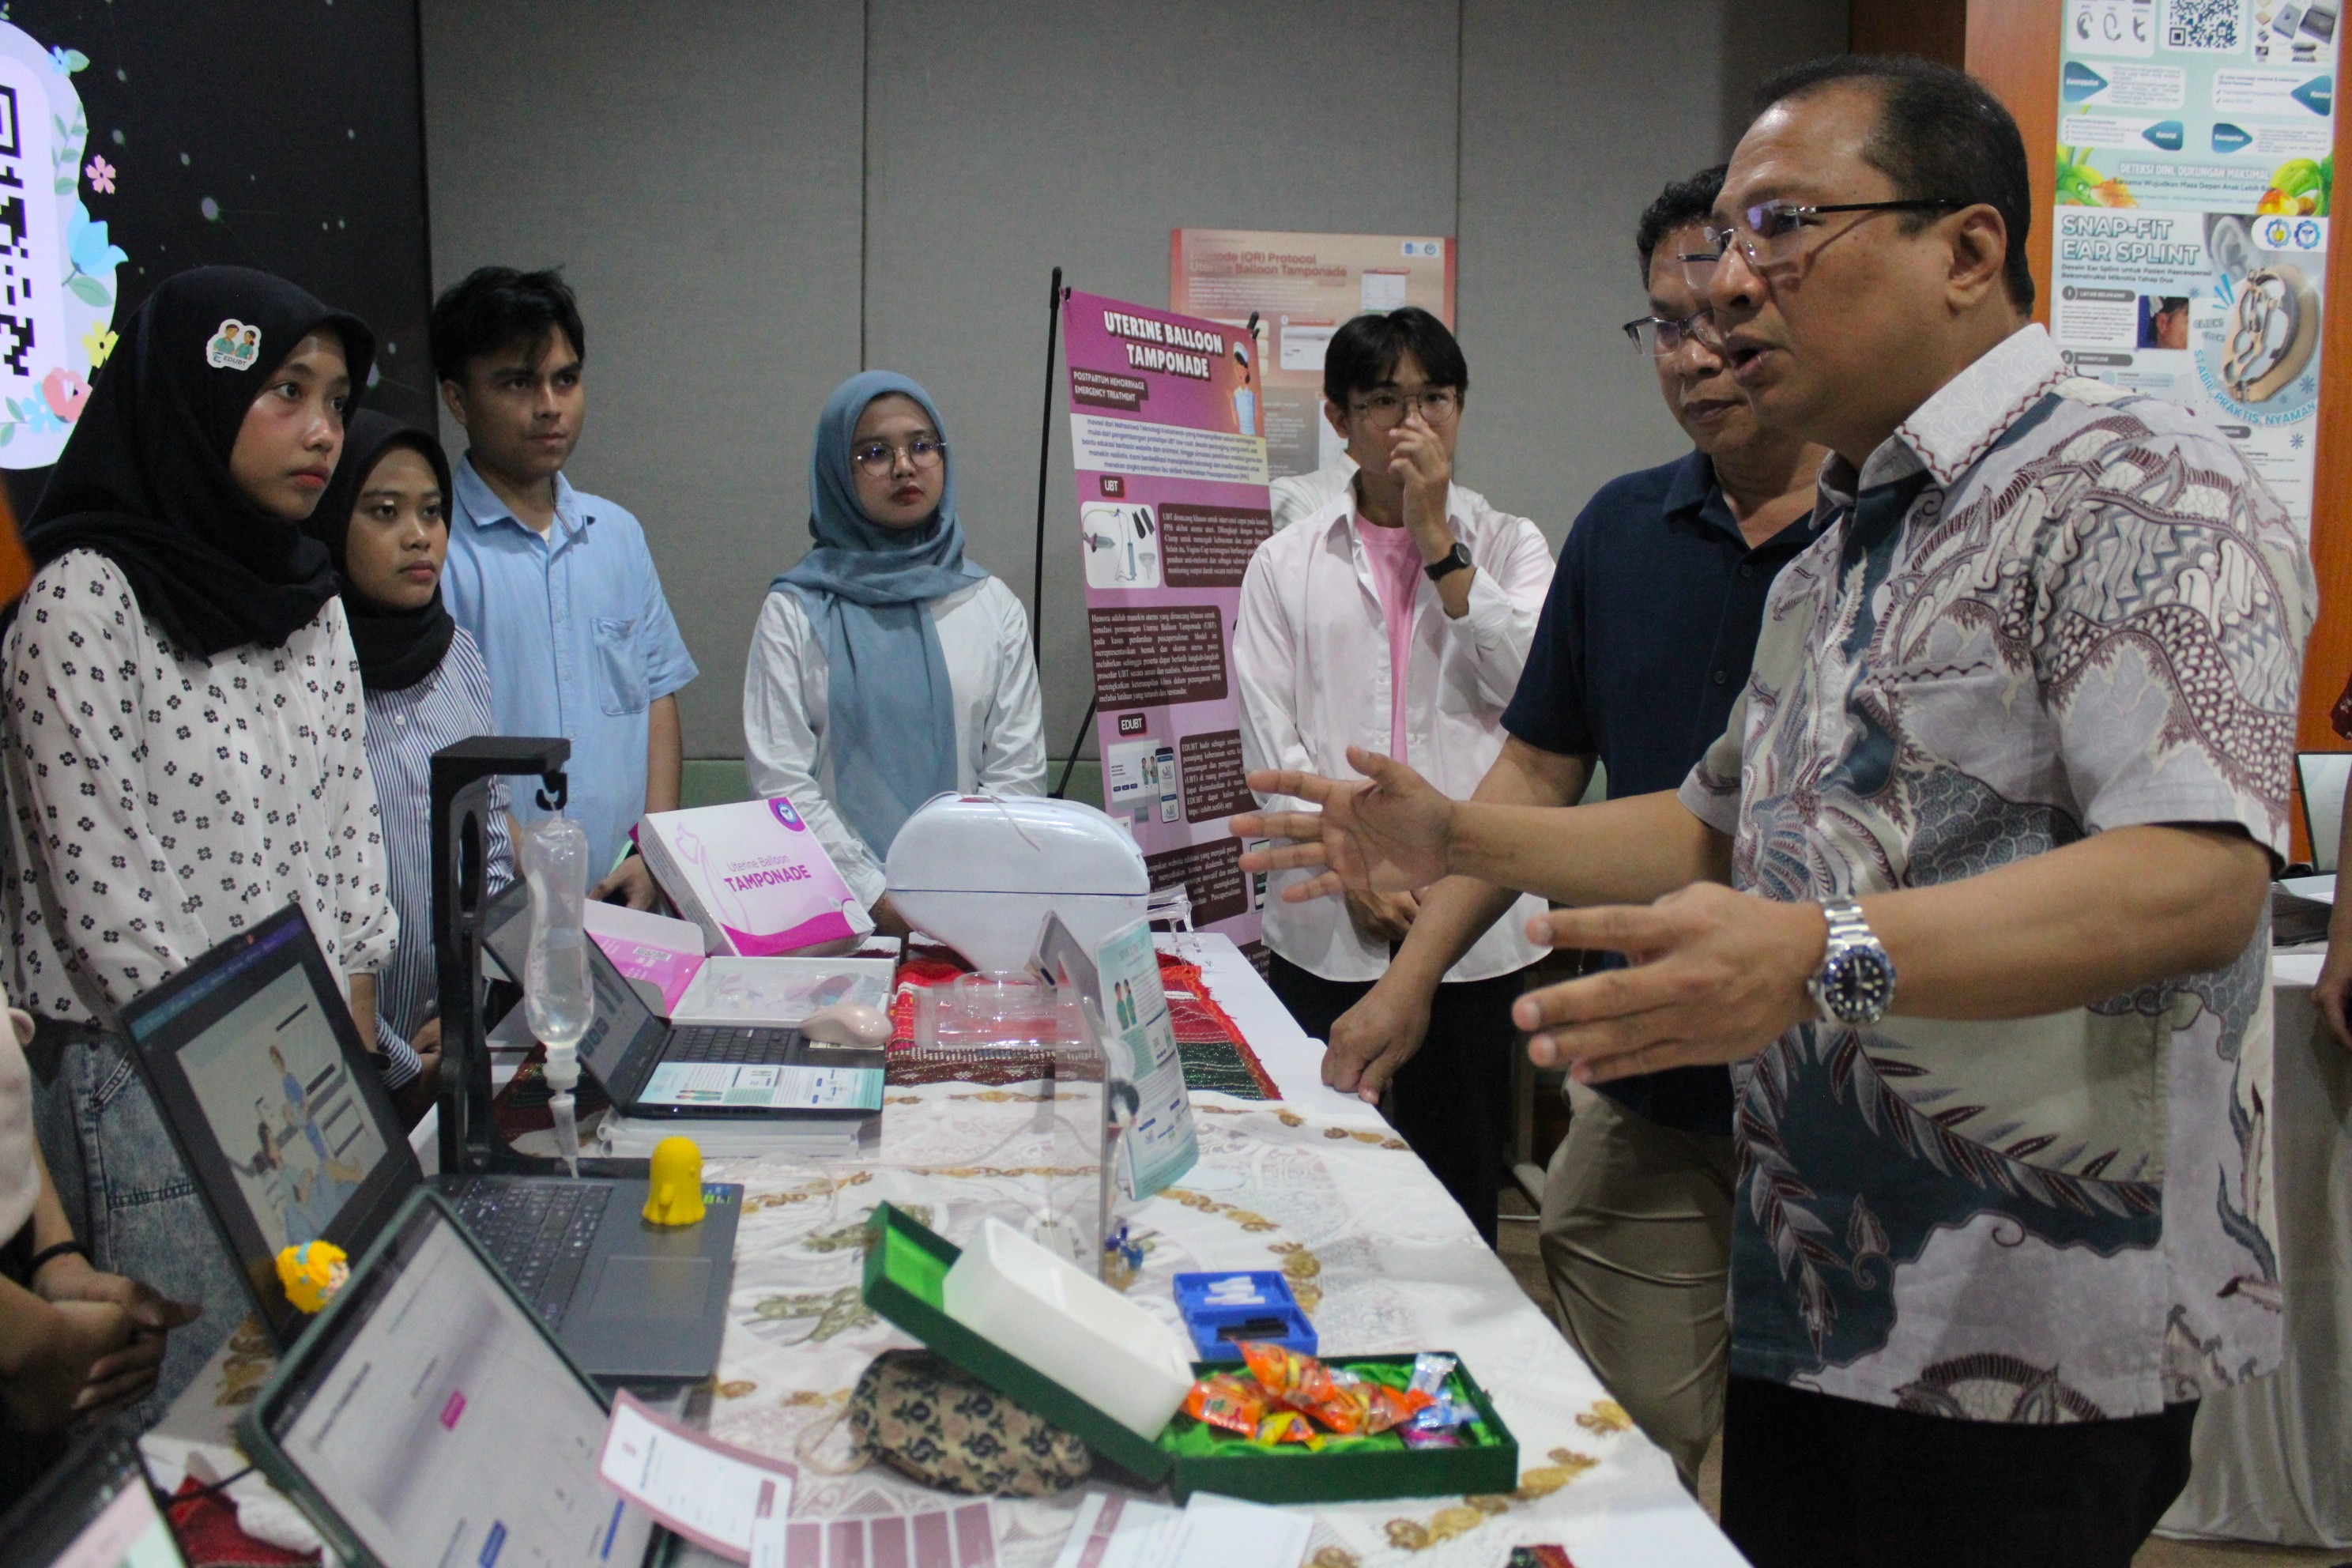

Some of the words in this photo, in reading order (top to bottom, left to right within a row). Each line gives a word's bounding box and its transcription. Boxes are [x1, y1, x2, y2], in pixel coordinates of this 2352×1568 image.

[2120, 163, 2154, 175] DETEKSI
[2178, 165, 2226, 178] DUKUNGAN
[2226, 168, 2269, 180] MAKSIMAL
[2199, 183, 2220, 191] Depan
[2062, 214, 2173, 239] SNAP-FIT
[1268, 252, 1316, 264] Protocol
[2062, 239, 2110, 262] EAR
[2116, 242, 2199, 266] SPLINT
[1235, 263, 1278, 274] Balloon
[1282, 265, 1348, 277] Tamponade
[1103, 311, 1163, 341] UTERINE
[1164, 323, 1223, 354] BALLOON
[223, 355, 247, 366] EDUBT
[1126, 343, 1209, 378] TAMPONADE
[1073, 371, 1110, 385] POSTPARTUM
[1110, 377, 1145, 390] HEMORRHAGE
[1075, 385, 1106, 397] EMERGENCY
[1106, 390, 1136, 401] TREATMENT
[2265, 402, 2316, 425] NYAMAN
[1104, 480, 1119, 492] UBT
[1121, 718, 1143, 730] EDUBT
[726, 860, 759, 872] Uterine
[757, 855, 790, 867] Balloon
[724, 865, 812, 892] TAMPONADE
